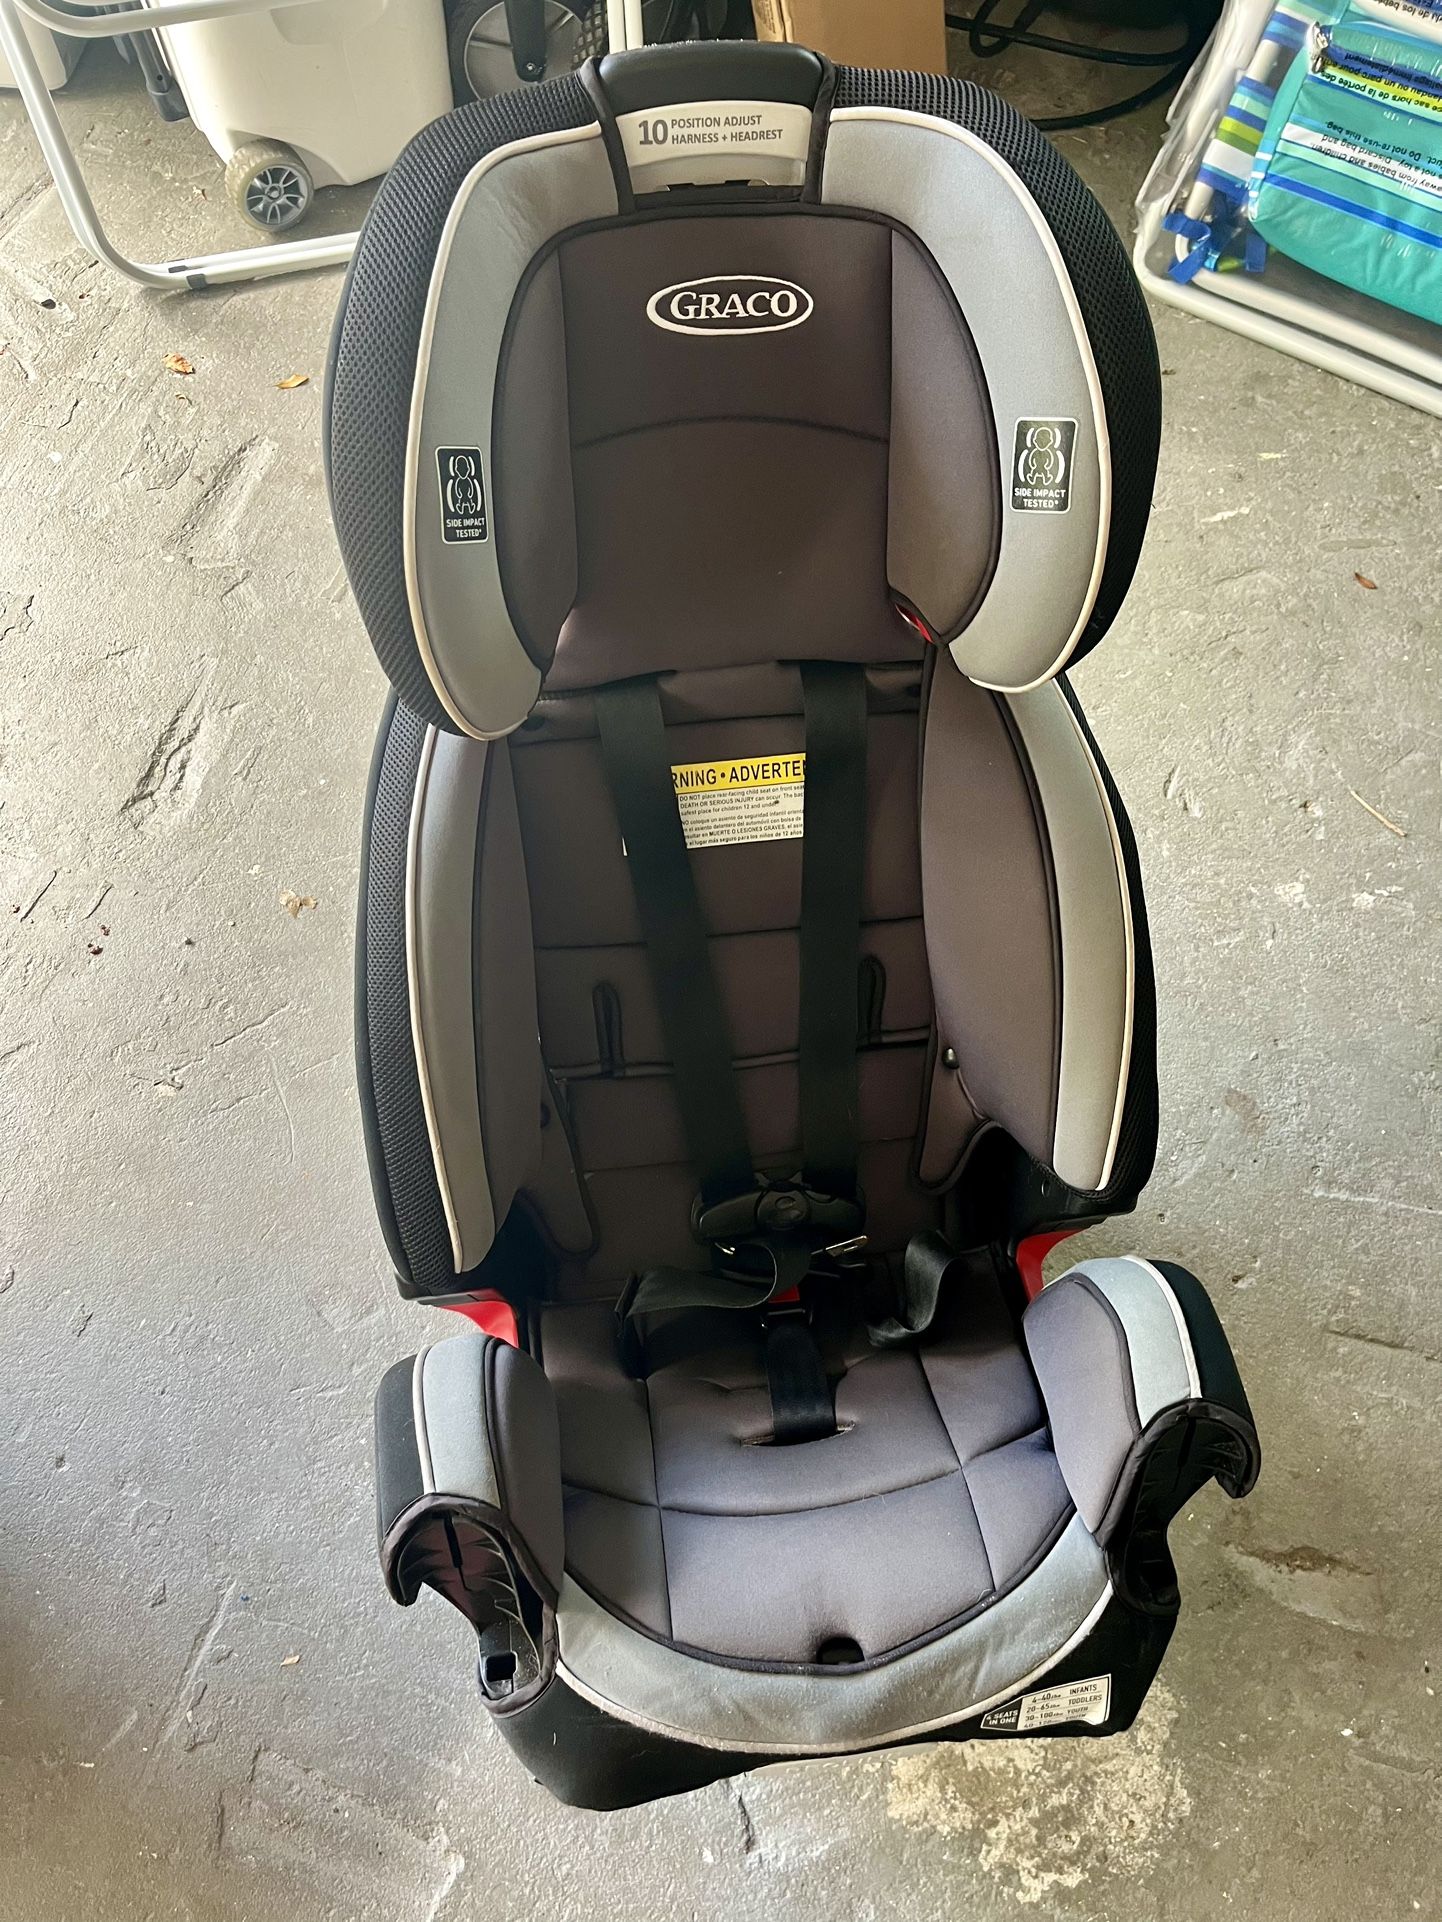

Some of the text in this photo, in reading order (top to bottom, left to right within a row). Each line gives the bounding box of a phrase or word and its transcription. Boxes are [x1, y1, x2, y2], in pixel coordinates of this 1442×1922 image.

[1402, 5, 1416, 16] los
[1362, 72, 1383, 83] parc
[1384, 79, 1396, 87] un
[1339, 76, 1367, 92] portée
[1397, 83, 1409, 91] ou
[1367, 88, 1376, 98] la
[1378, 91, 1390, 100] de
[1392, 94, 1411, 105] hors
[1414, 100, 1429, 108] sac
[671, 114, 763, 129] POSITION ADJUST
[638, 119, 669, 146] 10
[671, 132, 719, 145] HARNESS
[730, 129, 783, 143] HEADREST
[1345, 128, 1362, 141] this
[1321, 133, 1340, 145] and
[1363, 136, 1391, 150] re-use
[1340, 138, 1357, 153] bag
[1392, 142, 1407, 154] not
[1349, 155, 1366, 166] and
[1358, 146, 1392, 164] Discard
[1409, 150, 1422, 161] Do
[1368, 161, 1398, 180] babies
[1421, 168, 1437, 177] not
[1398, 172, 1417, 185] from
[669, 290, 798, 320] GRACO
[1014, 488, 1066, 498] SIDE IMPACT
[446, 518, 485, 527] SIDE IMPACT
[710, 798, 733, 806] SERIOUS
[737, 826, 763, 834] LESIONES
[1069, 1684, 1097, 1695] INFANTS
[1068, 1694, 1102, 1705] TODDLERS
[993, 1710, 1018, 1719] SEATS
[1067, 1706, 1089, 1714] YOUTH
[1000, 1716, 1017, 1724] ONE
